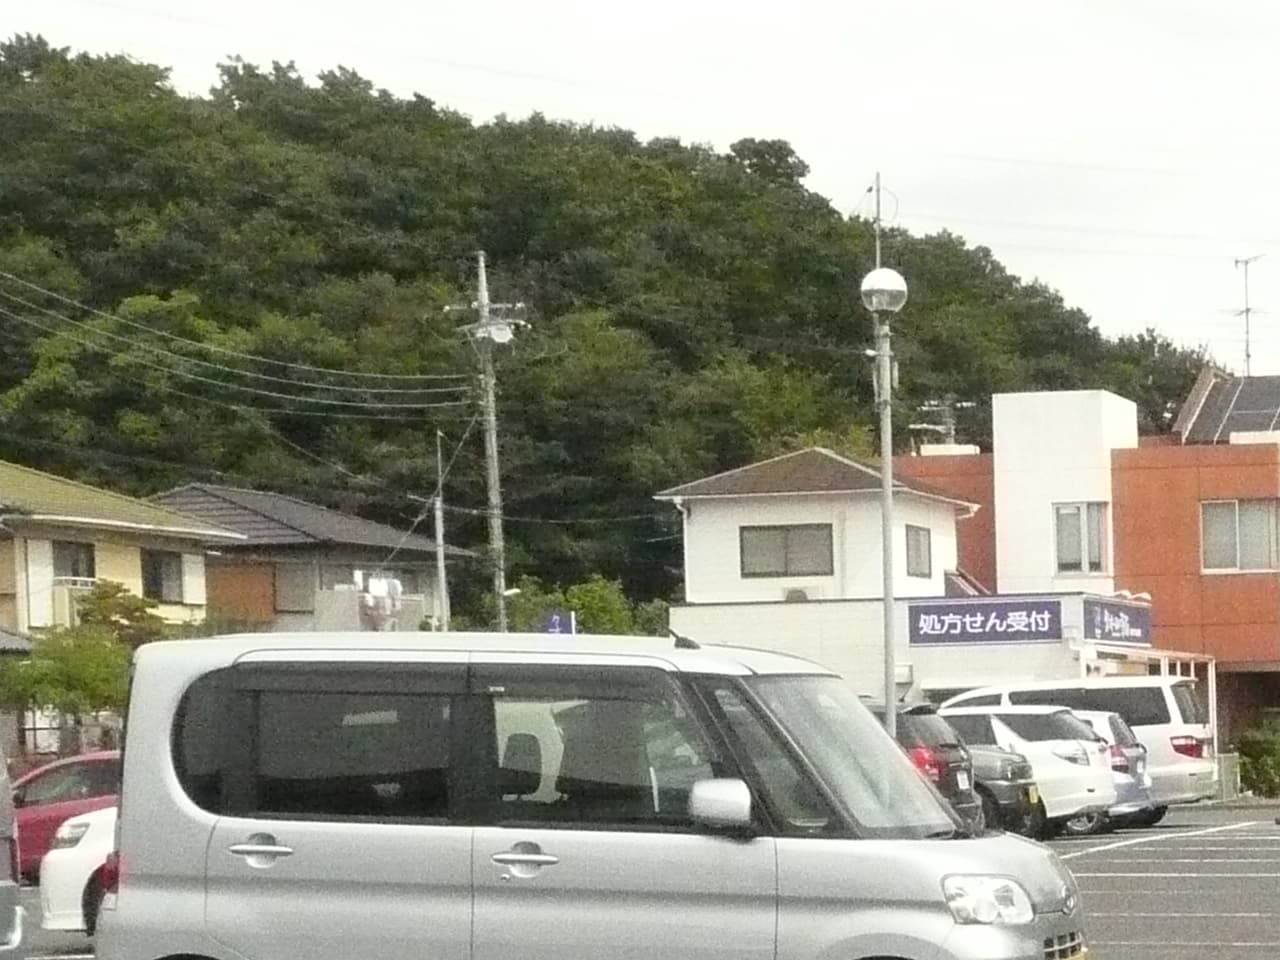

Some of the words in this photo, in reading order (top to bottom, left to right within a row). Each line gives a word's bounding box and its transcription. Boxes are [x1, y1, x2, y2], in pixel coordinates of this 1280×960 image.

[919, 611, 1050, 634] 処方せん受付
